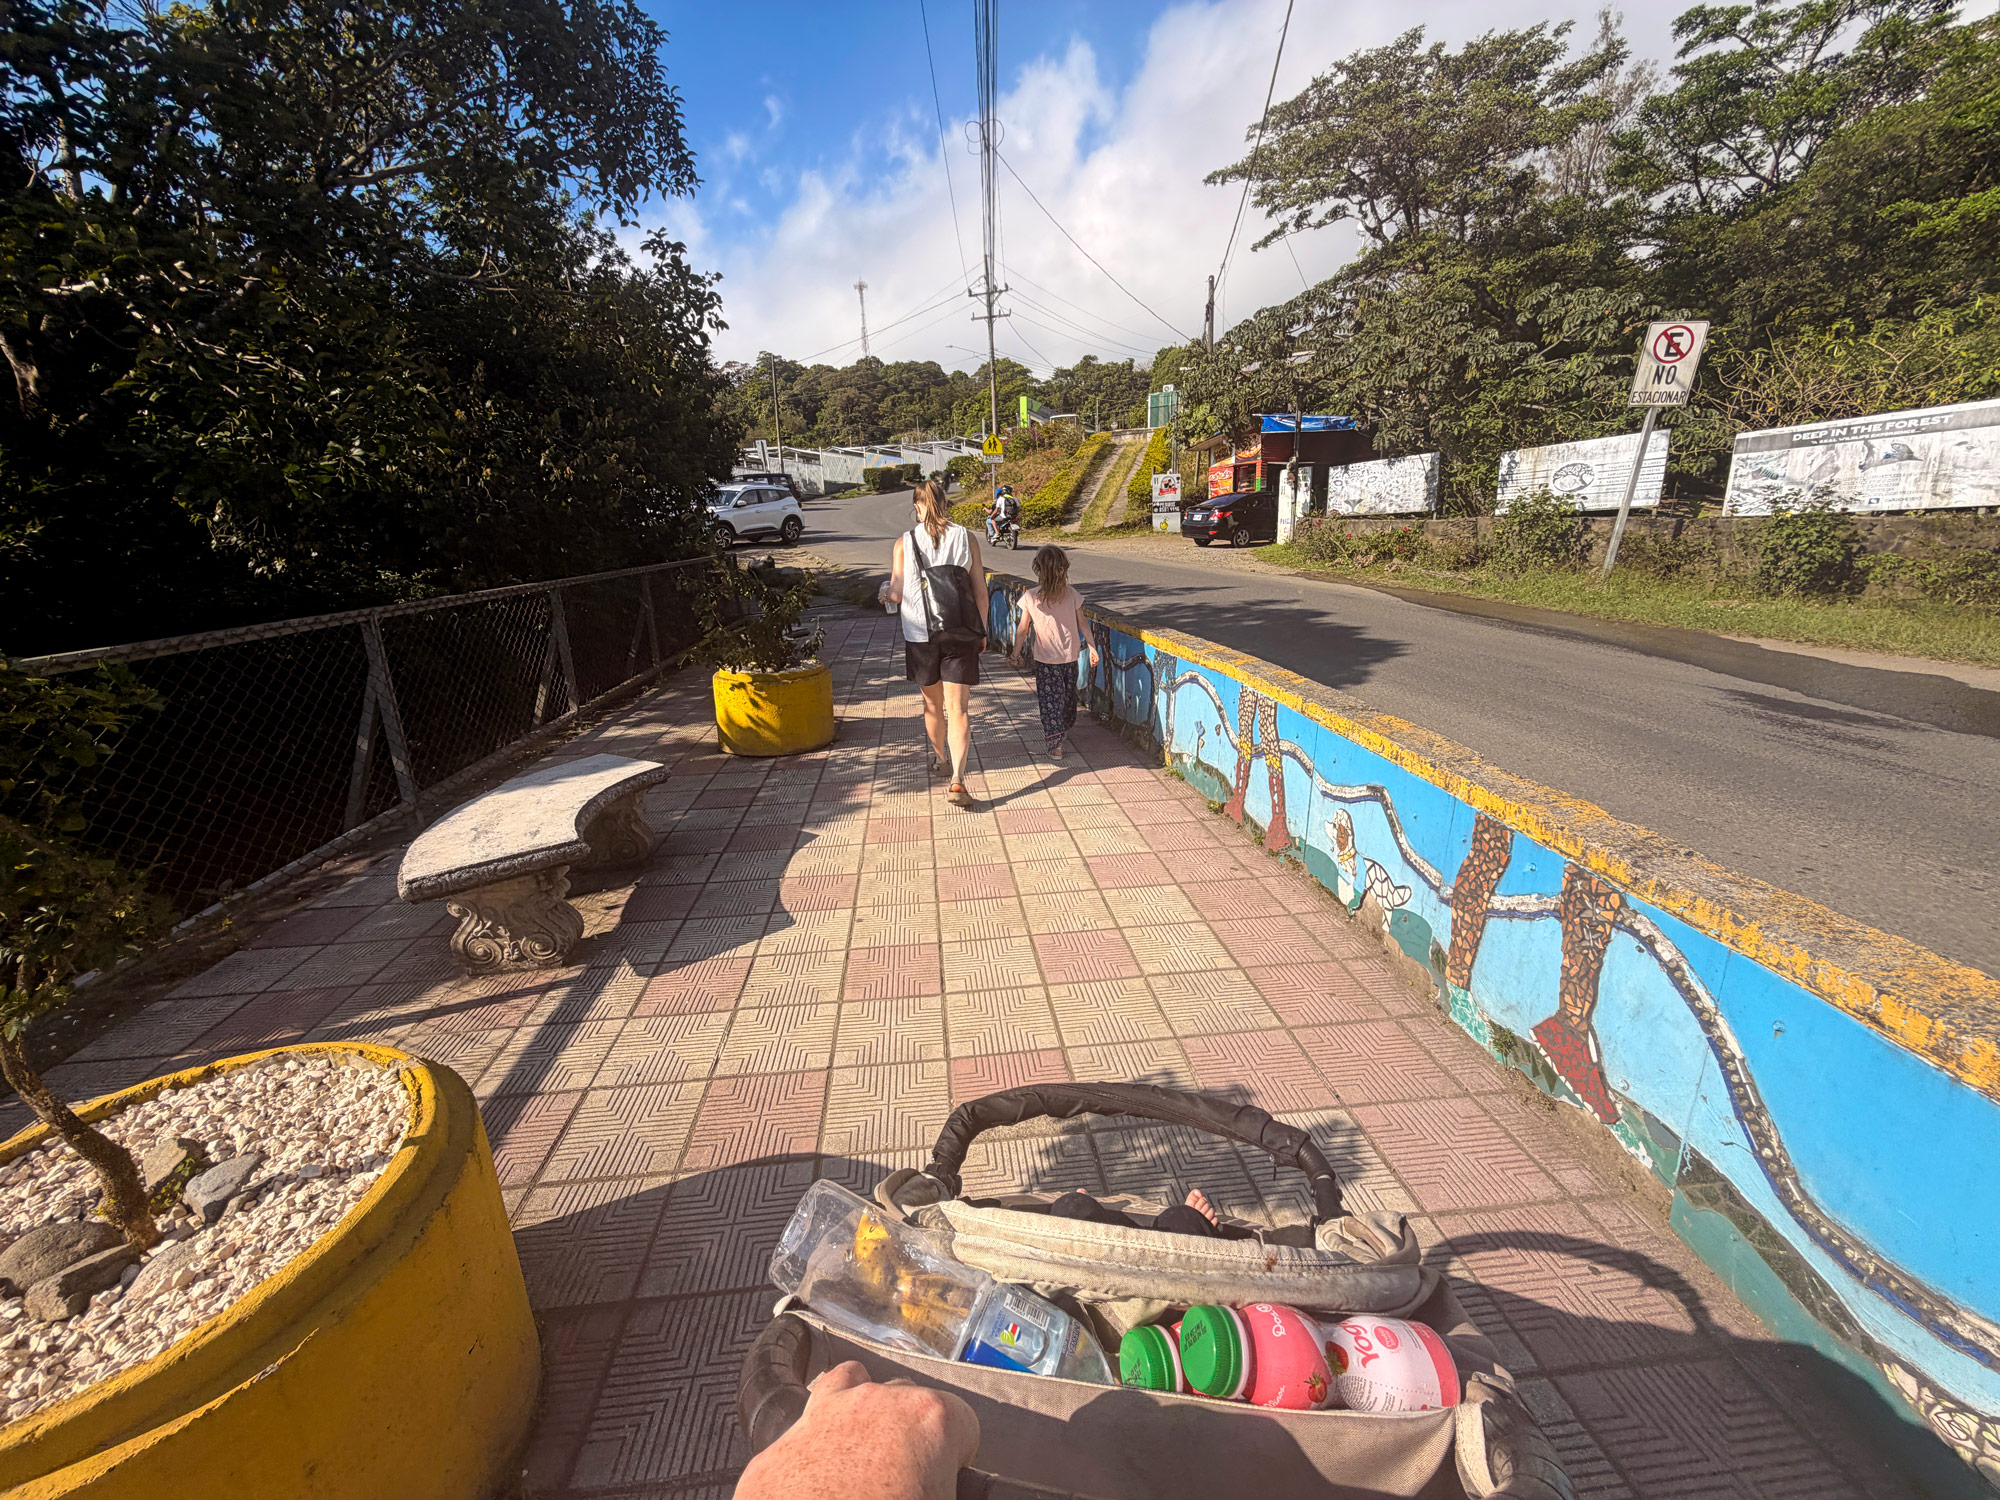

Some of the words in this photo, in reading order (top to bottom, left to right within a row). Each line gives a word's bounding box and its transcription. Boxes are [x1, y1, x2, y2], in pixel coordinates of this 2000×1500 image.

[1652, 365, 1677, 385] NO
[1631, 391, 1687, 404] ESTACIONAR
[1792, 430, 1828, 442] DEEP
[1831, 427, 1848, 437] IN
[1850, 422, 1883, 434] THE
[1885, 414, 1954, 431] FOREST
[1271, 1310, 1287, 1337] Dos
